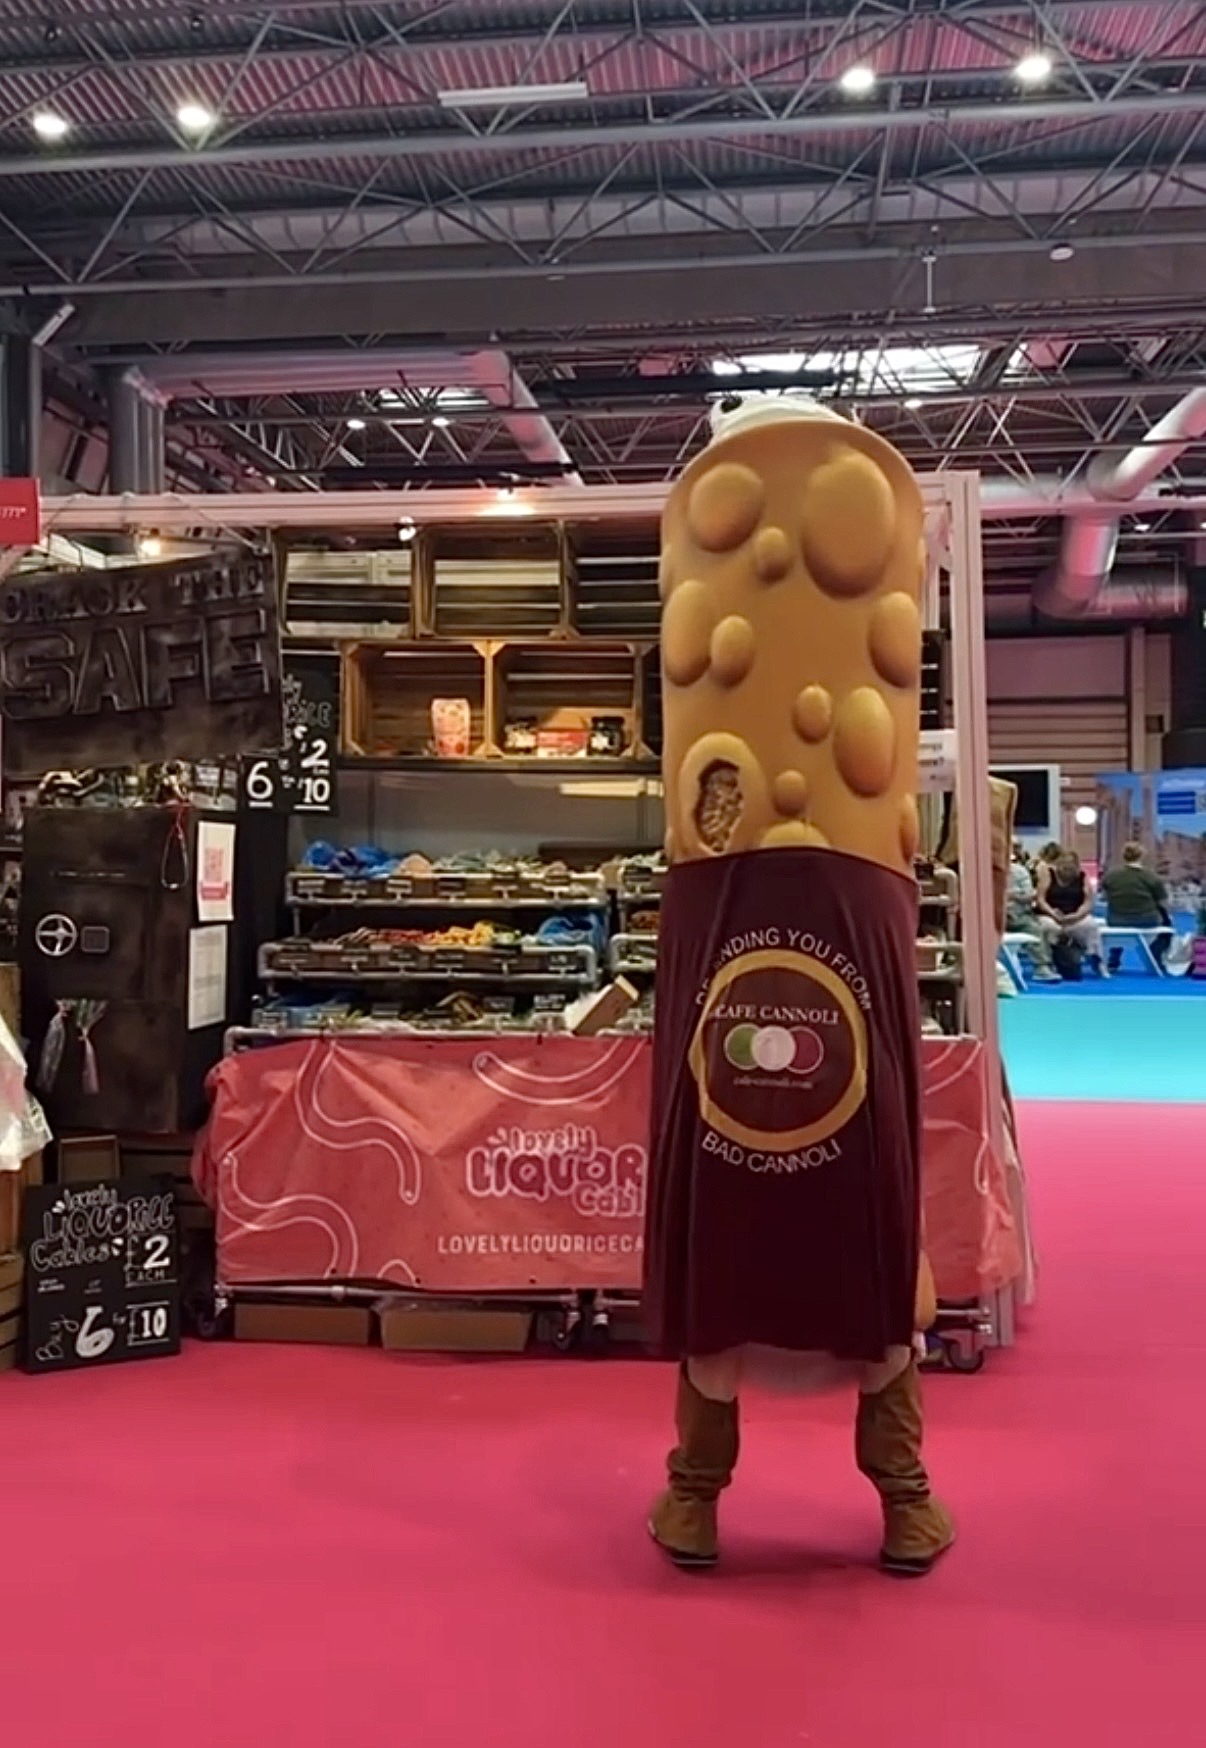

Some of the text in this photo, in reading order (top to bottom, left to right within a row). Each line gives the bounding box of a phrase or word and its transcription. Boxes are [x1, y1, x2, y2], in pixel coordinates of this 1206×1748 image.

[173, 561, 266, 605] THE
[1, 608, 271, 720] SAFE
[247, 761, 273, 799] 6
[298, 777, 331, 804] 10
[788, 929, 831, 960] YOU
[831, 953, 873, 1010] FROM
[760, 1005, 840, 1025] CANNOLI
[510, 1123, 597, 1160] lovely
[701, 1130, 843, 1174] BAD CANNOLI
[466, 1143, 648, 1201] LIQUOR
[437, 1234, 644, 1254] LOVELYLIQUORICECA
[75, 1305, 115, 1358] 6
